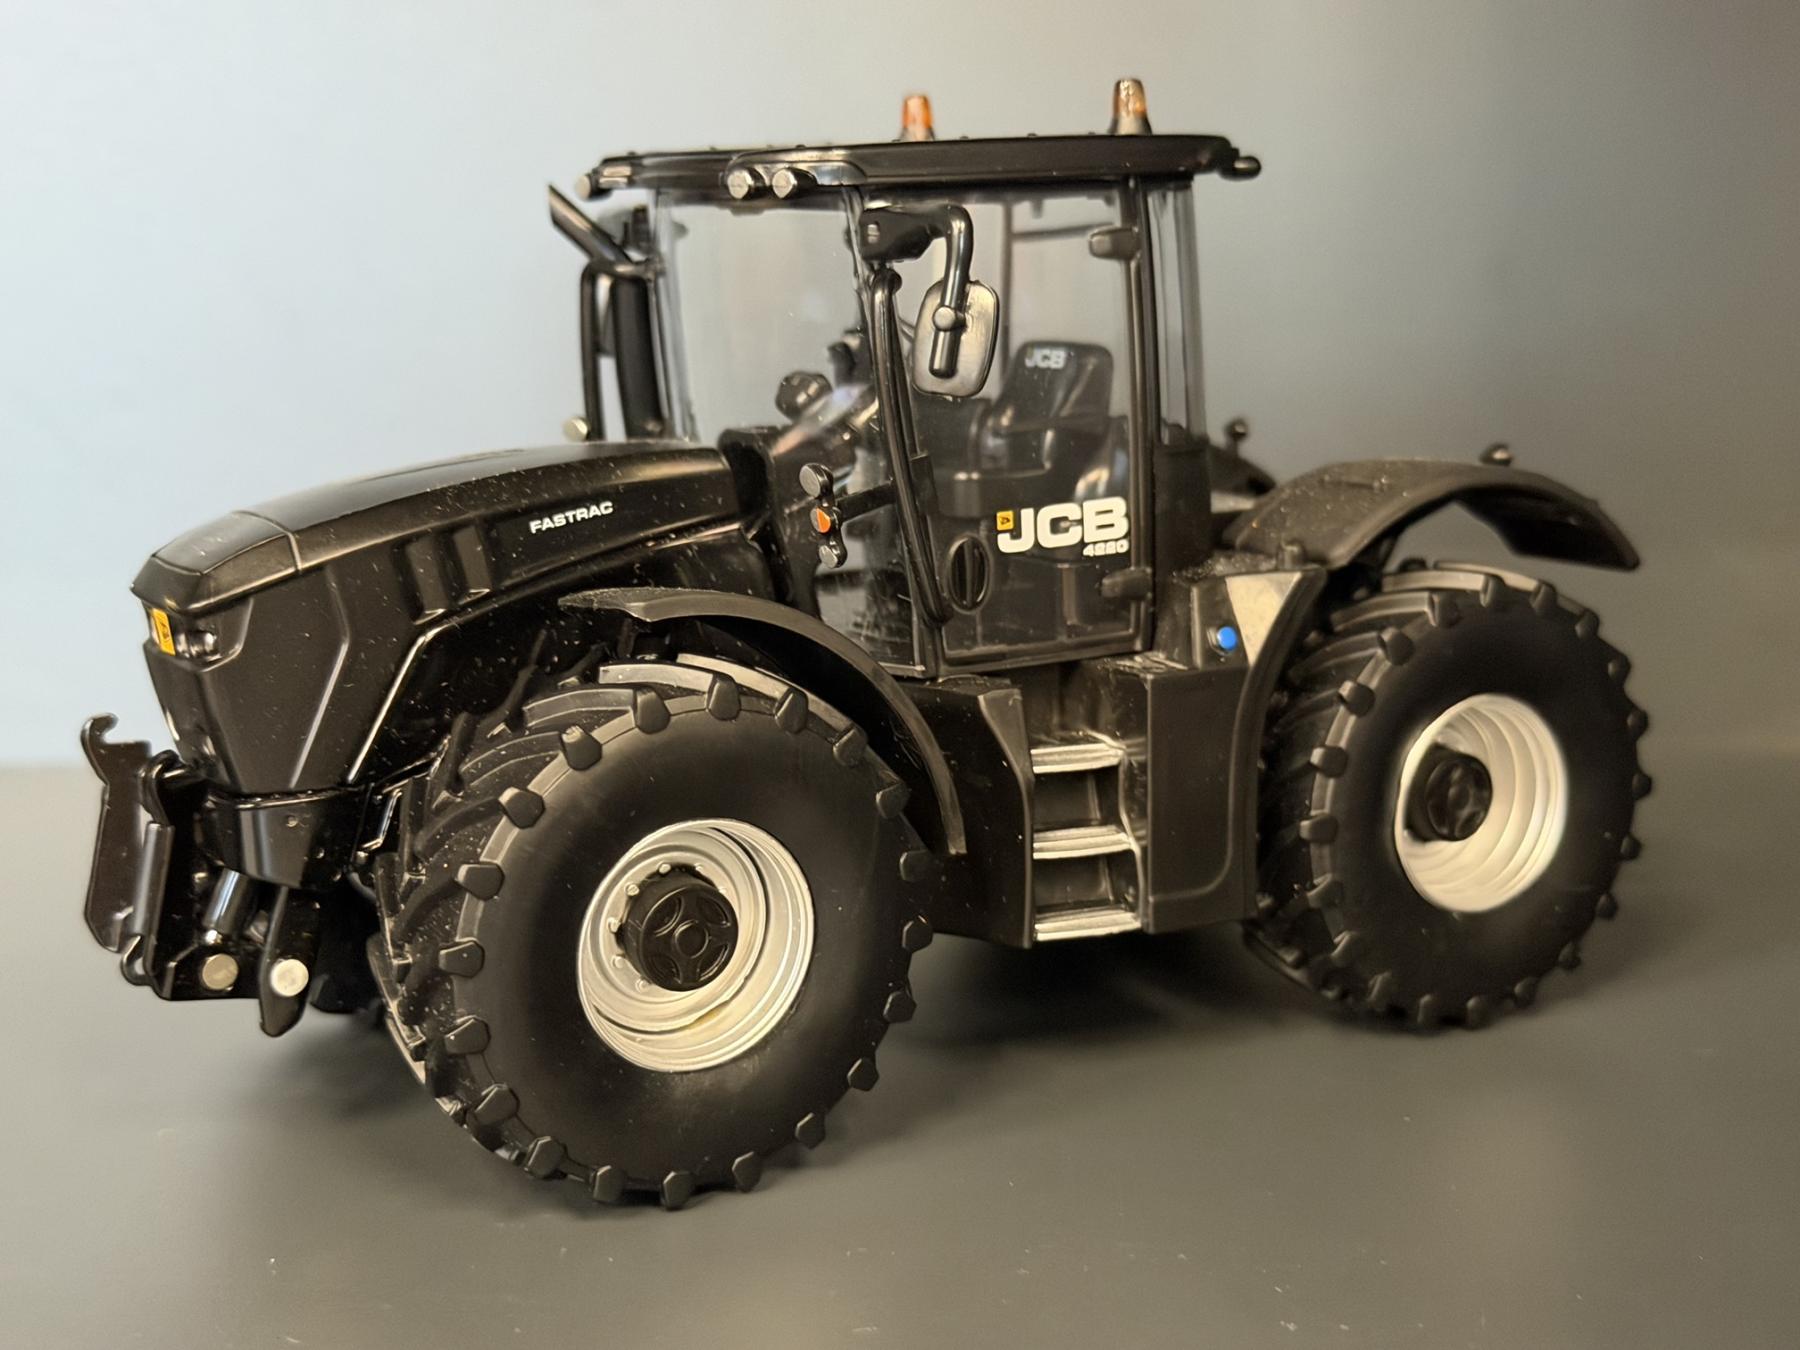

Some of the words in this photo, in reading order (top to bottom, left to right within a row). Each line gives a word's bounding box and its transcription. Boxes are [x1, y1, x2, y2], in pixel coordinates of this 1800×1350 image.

[1025, 348, 1066, 369] JCB
[529, 501, 613, 534] FASTRAC
[997, 496, 1128, 553] JCB
